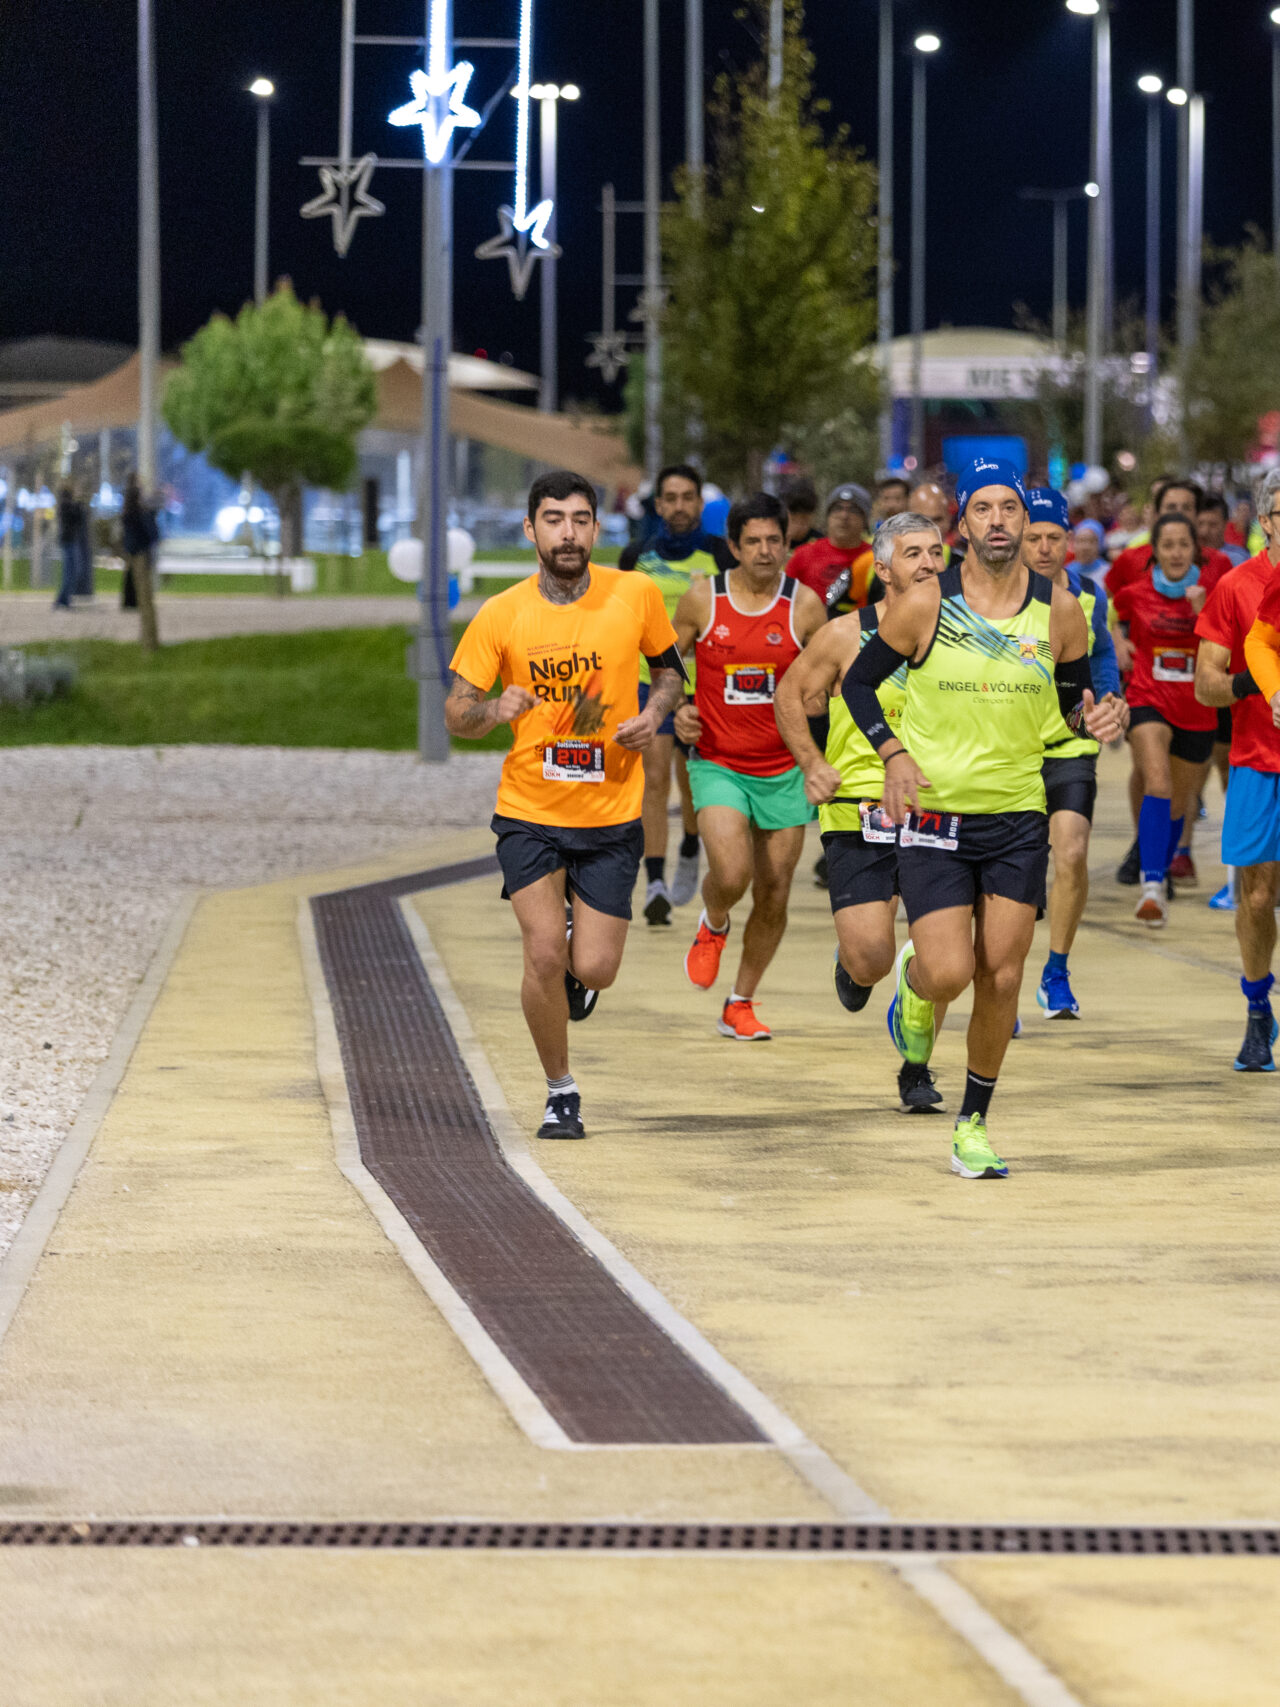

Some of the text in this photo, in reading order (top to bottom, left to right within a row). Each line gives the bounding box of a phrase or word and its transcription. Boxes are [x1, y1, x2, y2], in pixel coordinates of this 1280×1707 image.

[529, 651, 602, 682] Night
[736, 675, 766, 690] 107
[533, 684, 582, 707] Run
[557, 749, 592, 766] 210
